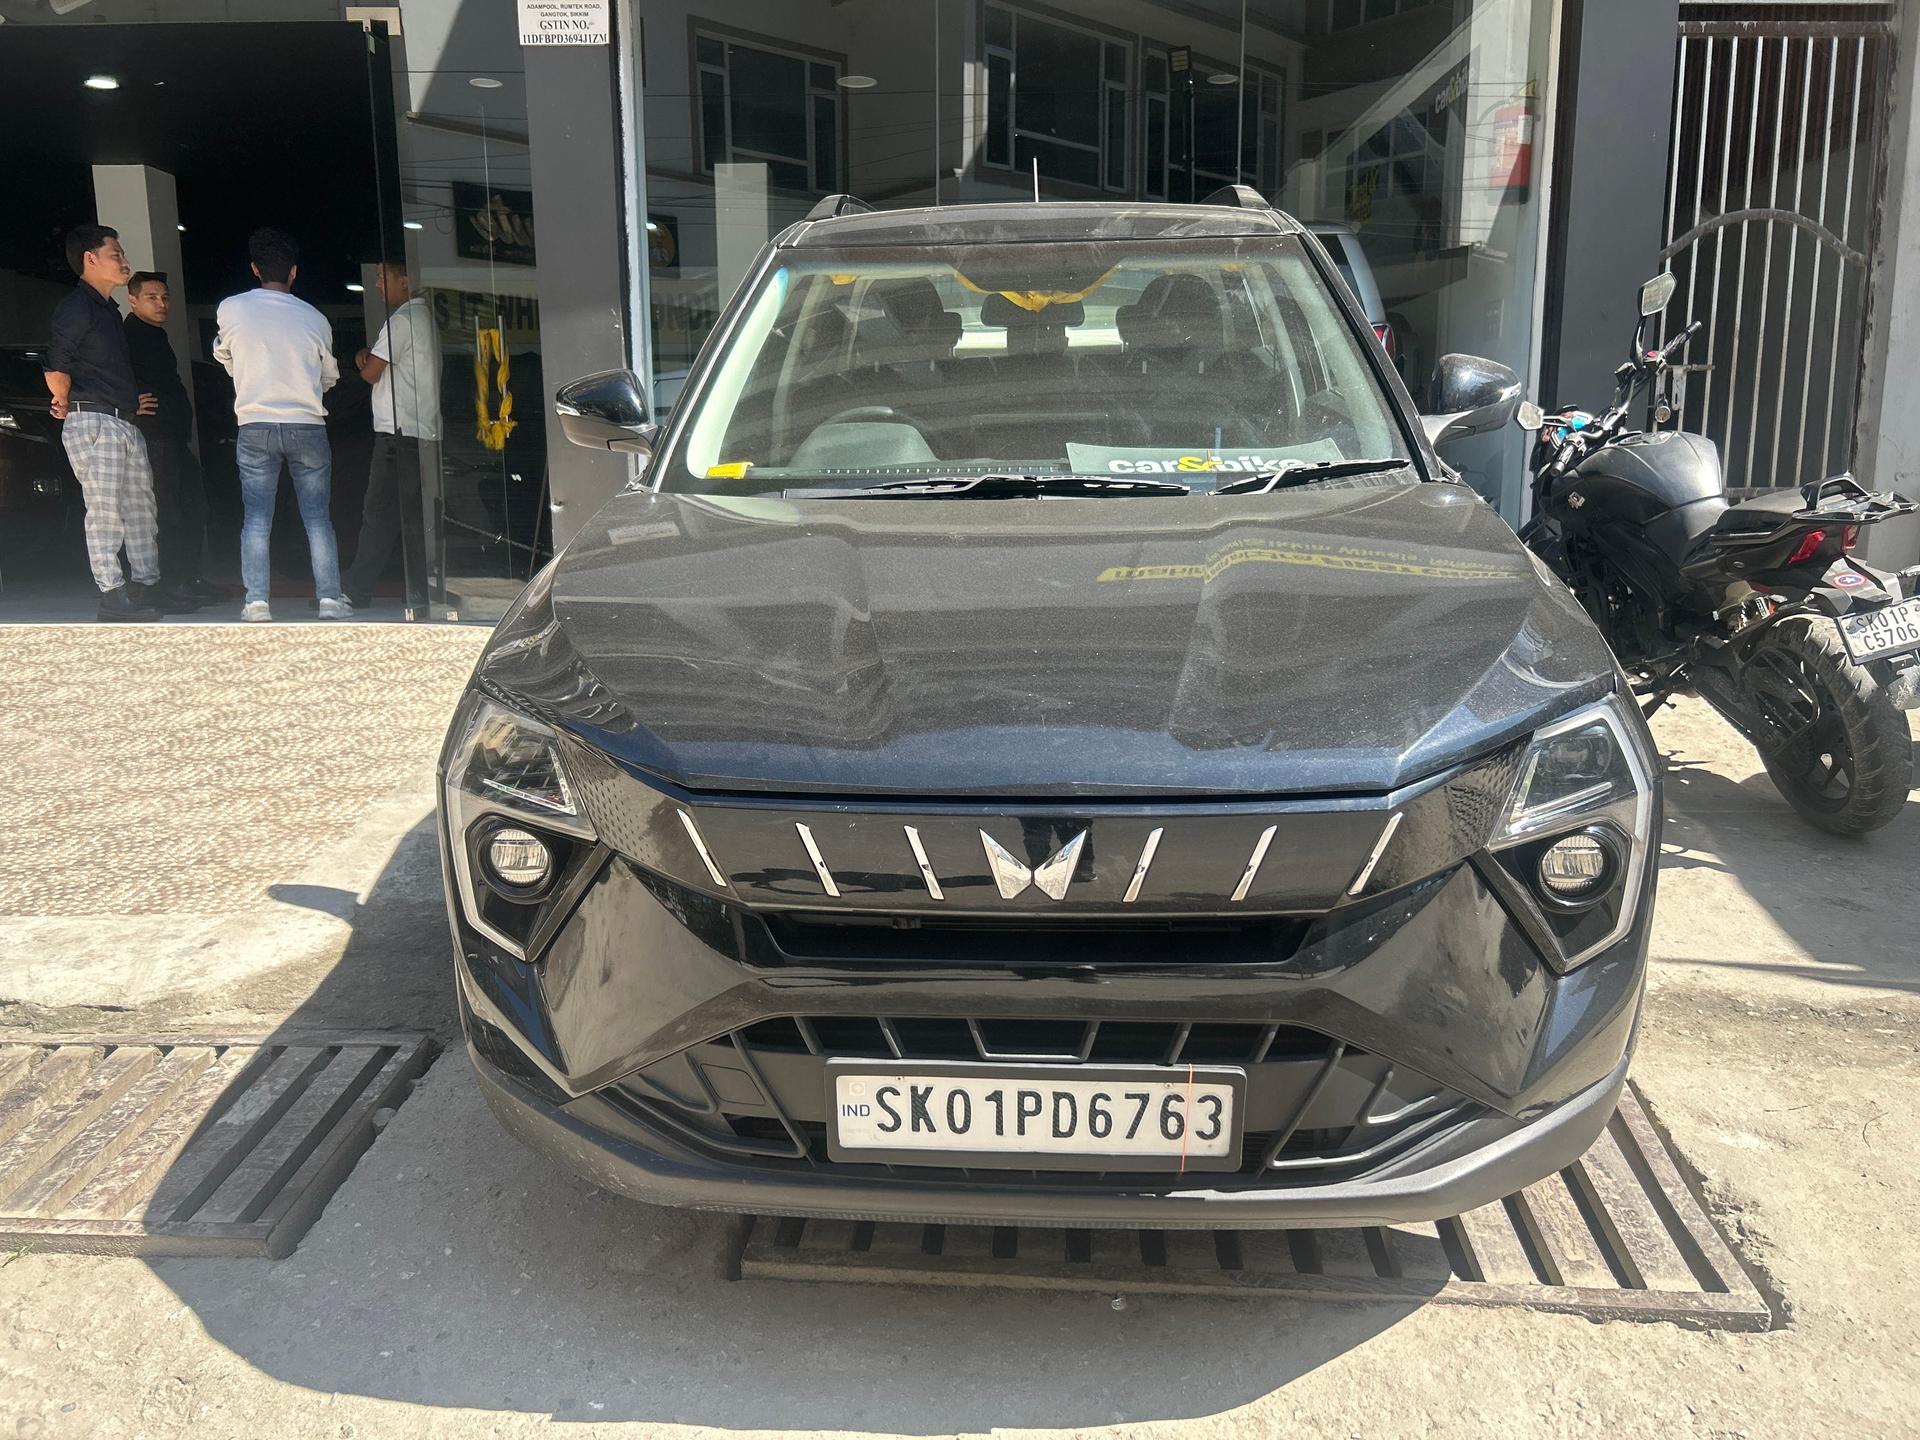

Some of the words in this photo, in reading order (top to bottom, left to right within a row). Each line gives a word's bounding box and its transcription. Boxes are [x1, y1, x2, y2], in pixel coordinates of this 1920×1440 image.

[540, 20, 570, 31] GSTIN
[1855, 606, 1909, 634] SK01P
[1863, 622, 1919, 651] C5706
[842, 1104, 871, 1117] IND
[875, 1084, 1224, 1142] SK01PD6763
